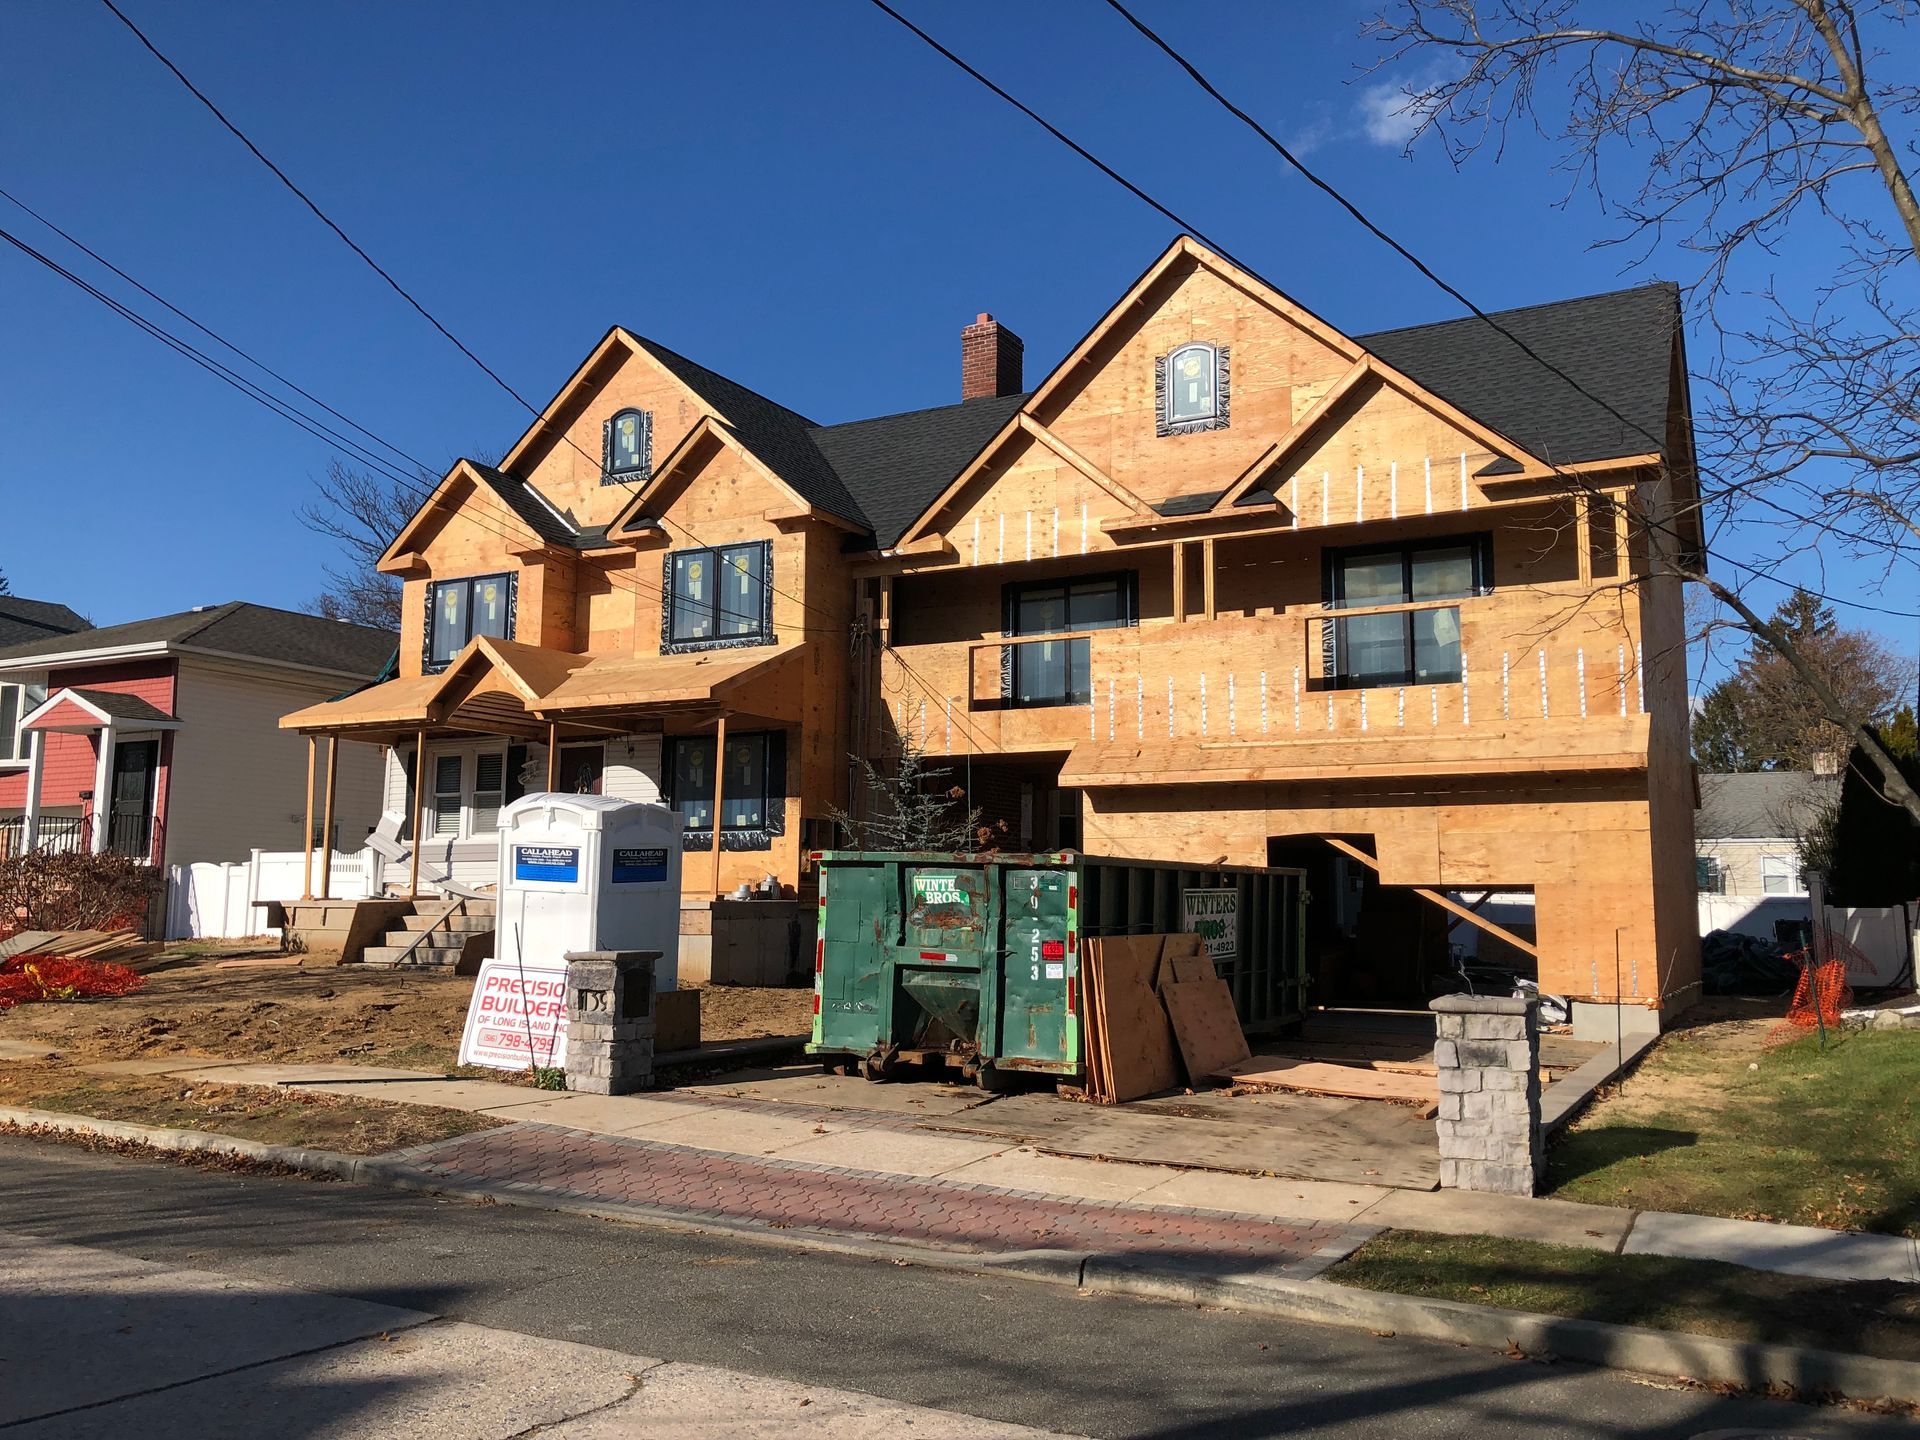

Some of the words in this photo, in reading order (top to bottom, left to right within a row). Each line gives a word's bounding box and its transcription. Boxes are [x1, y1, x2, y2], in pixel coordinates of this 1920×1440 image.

[521, 848, 573, 857] CALLAHEAD
[915, 879, 960, 891] WINTE
[925, 891, 965, 904] BROS.
[1185, 894, 1236, 915] WINTERS
[1204, 941, 1234, 953] 91-4923
[486, 976, 567, 998] PRECISIO
[481, 995, 568, 1018] BUILDERS
[478, 1014, 491, 1024] OF
[493, 1016, 516, 1027] LONG
[518, 1020, 550, 1031] ISAND
